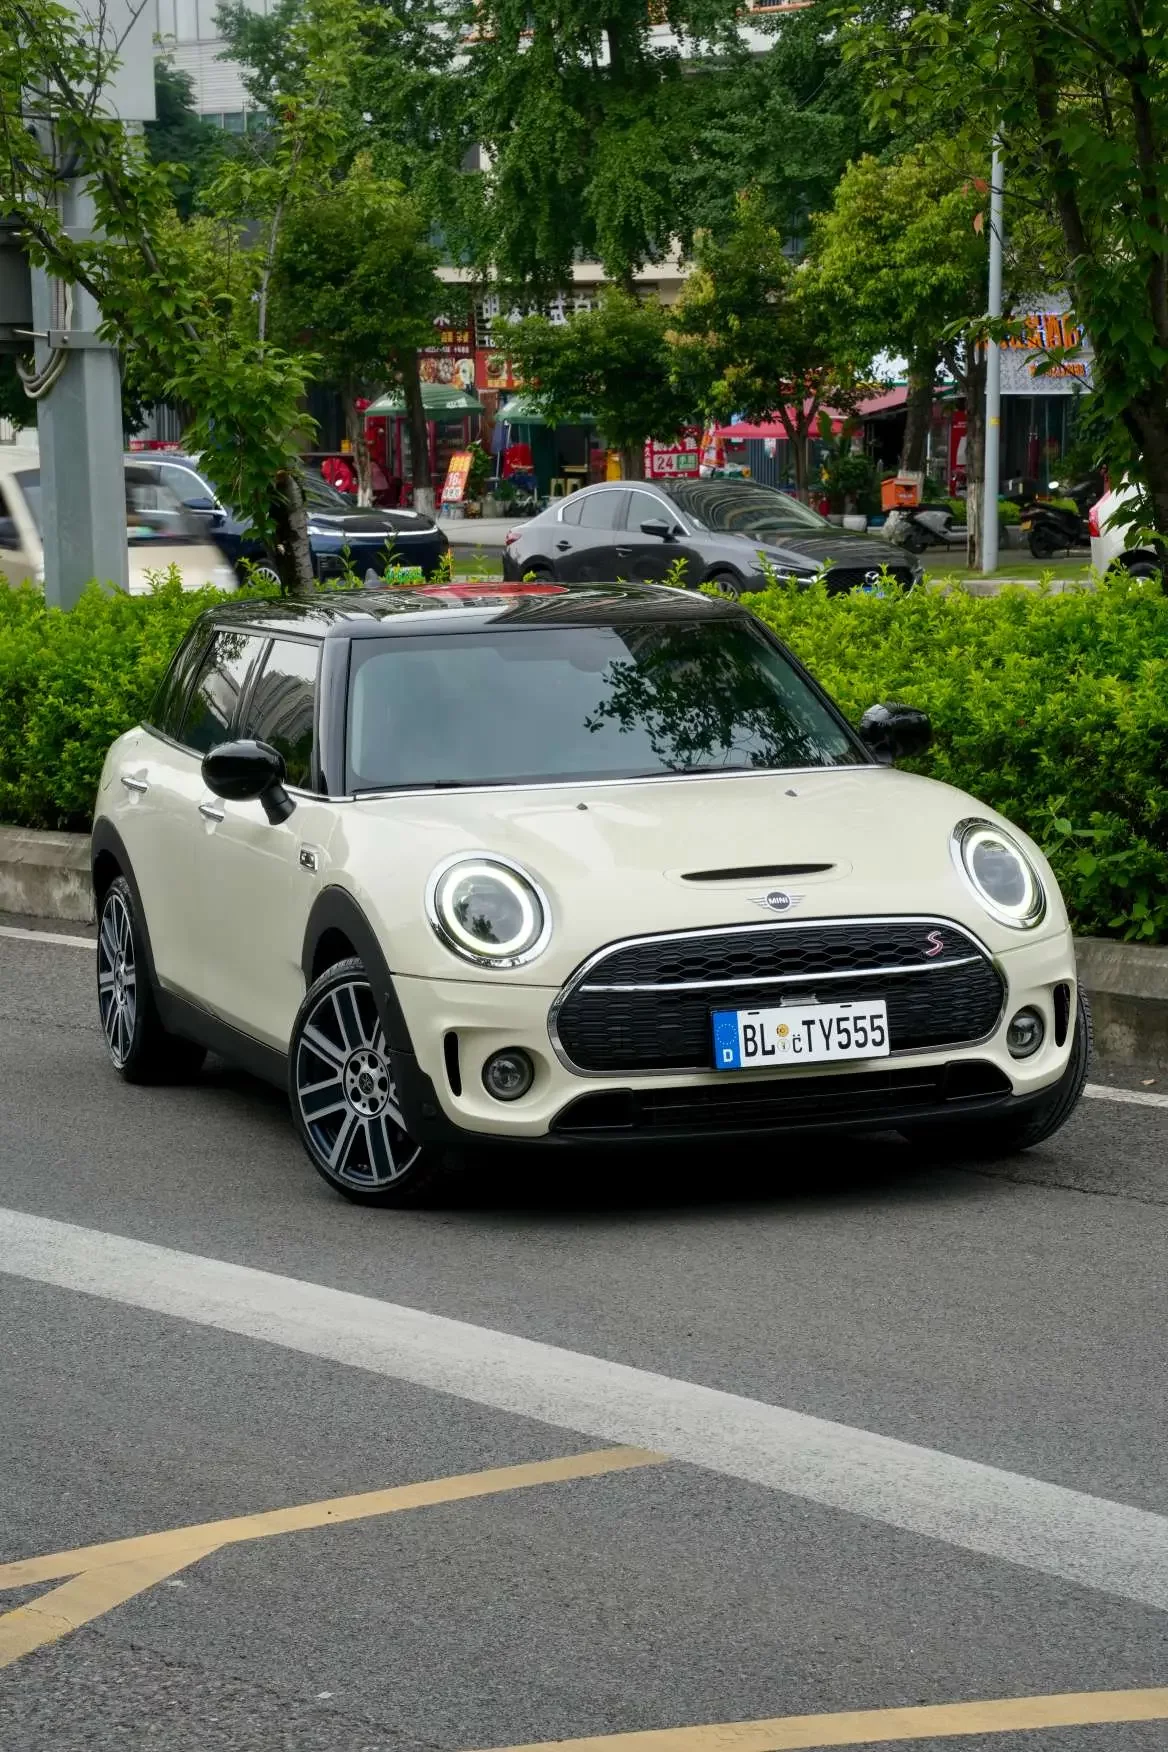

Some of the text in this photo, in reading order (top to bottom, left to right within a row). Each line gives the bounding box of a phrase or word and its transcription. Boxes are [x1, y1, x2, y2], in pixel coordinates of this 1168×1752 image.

[657, 456, 673, 470] 24
[768, 896, 789, 905] MINI
[926, 931, 944, 956] S
[722, 1049, 734, 1063] D
